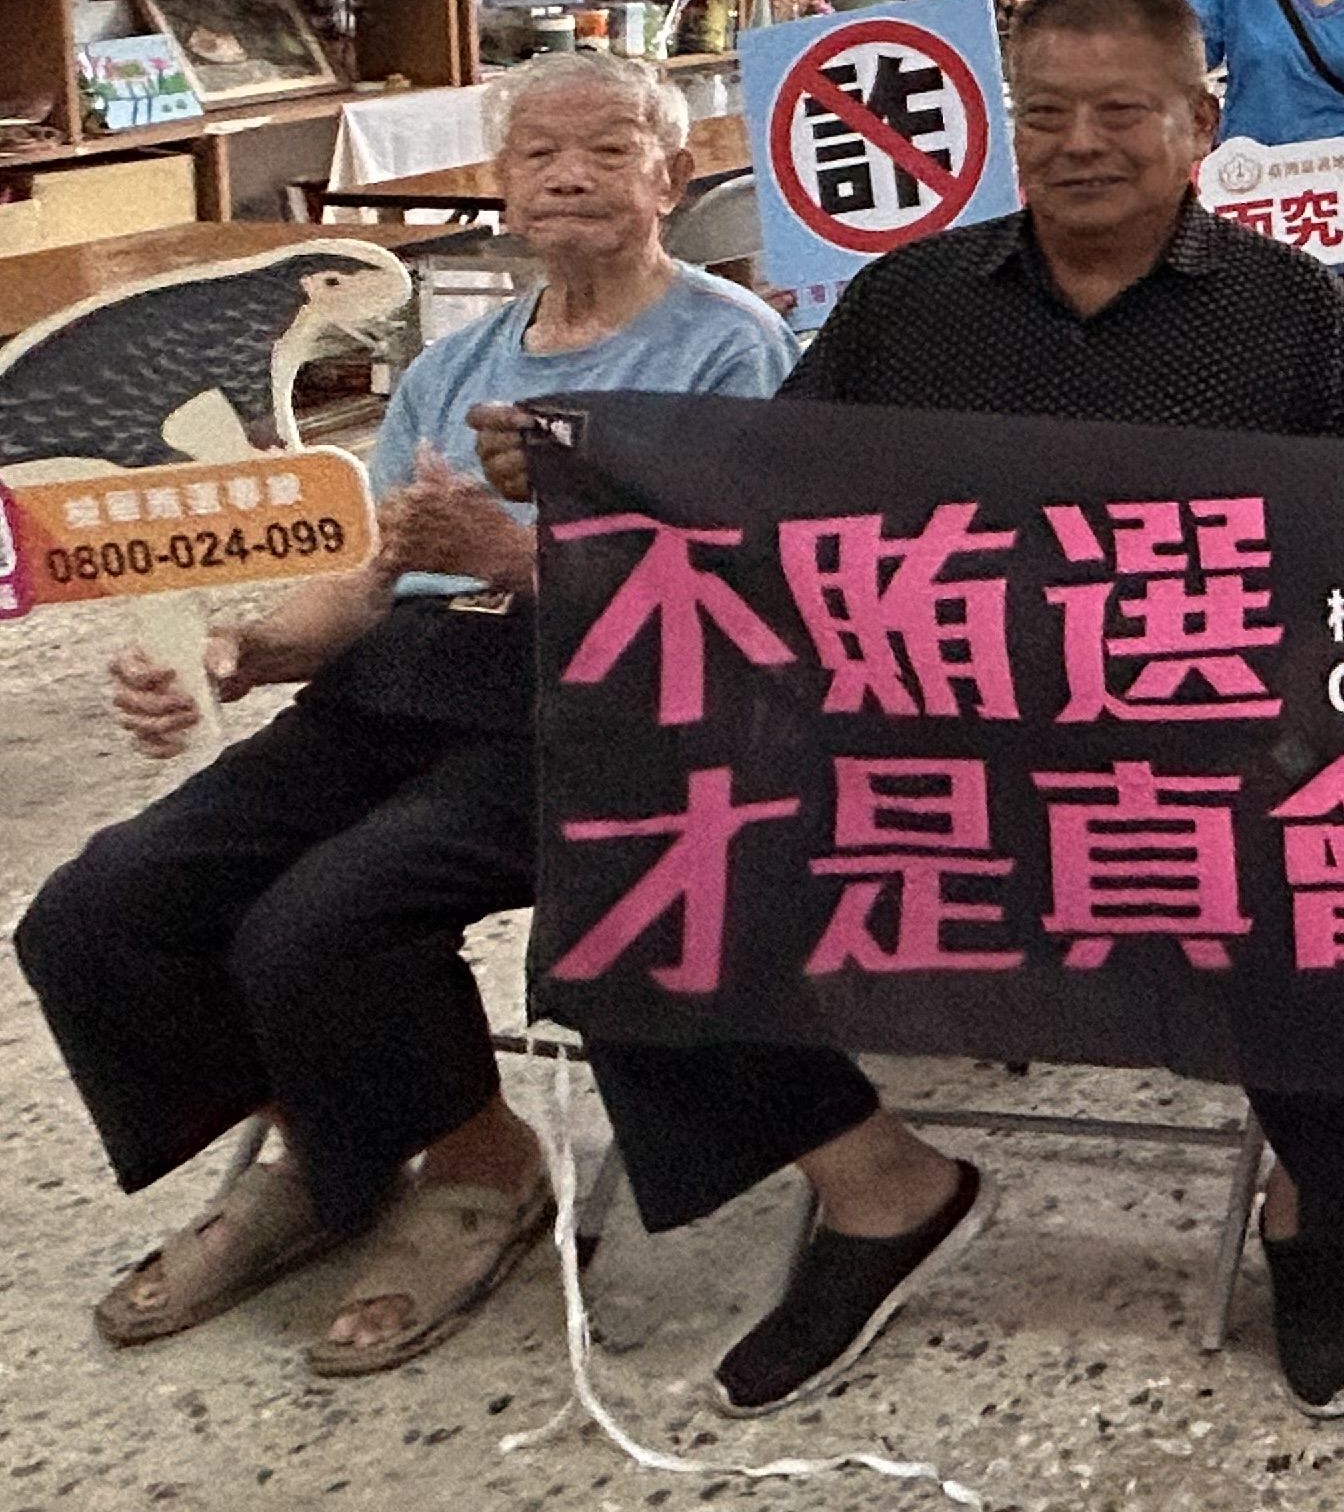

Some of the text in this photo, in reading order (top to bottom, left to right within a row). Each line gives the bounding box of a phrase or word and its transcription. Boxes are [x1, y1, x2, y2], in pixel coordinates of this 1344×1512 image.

[805, 54, 952, 215] 詐
[47, 517, 345, 584] 0800-024-099
[549, 497, 1284, 726] 不賄選
